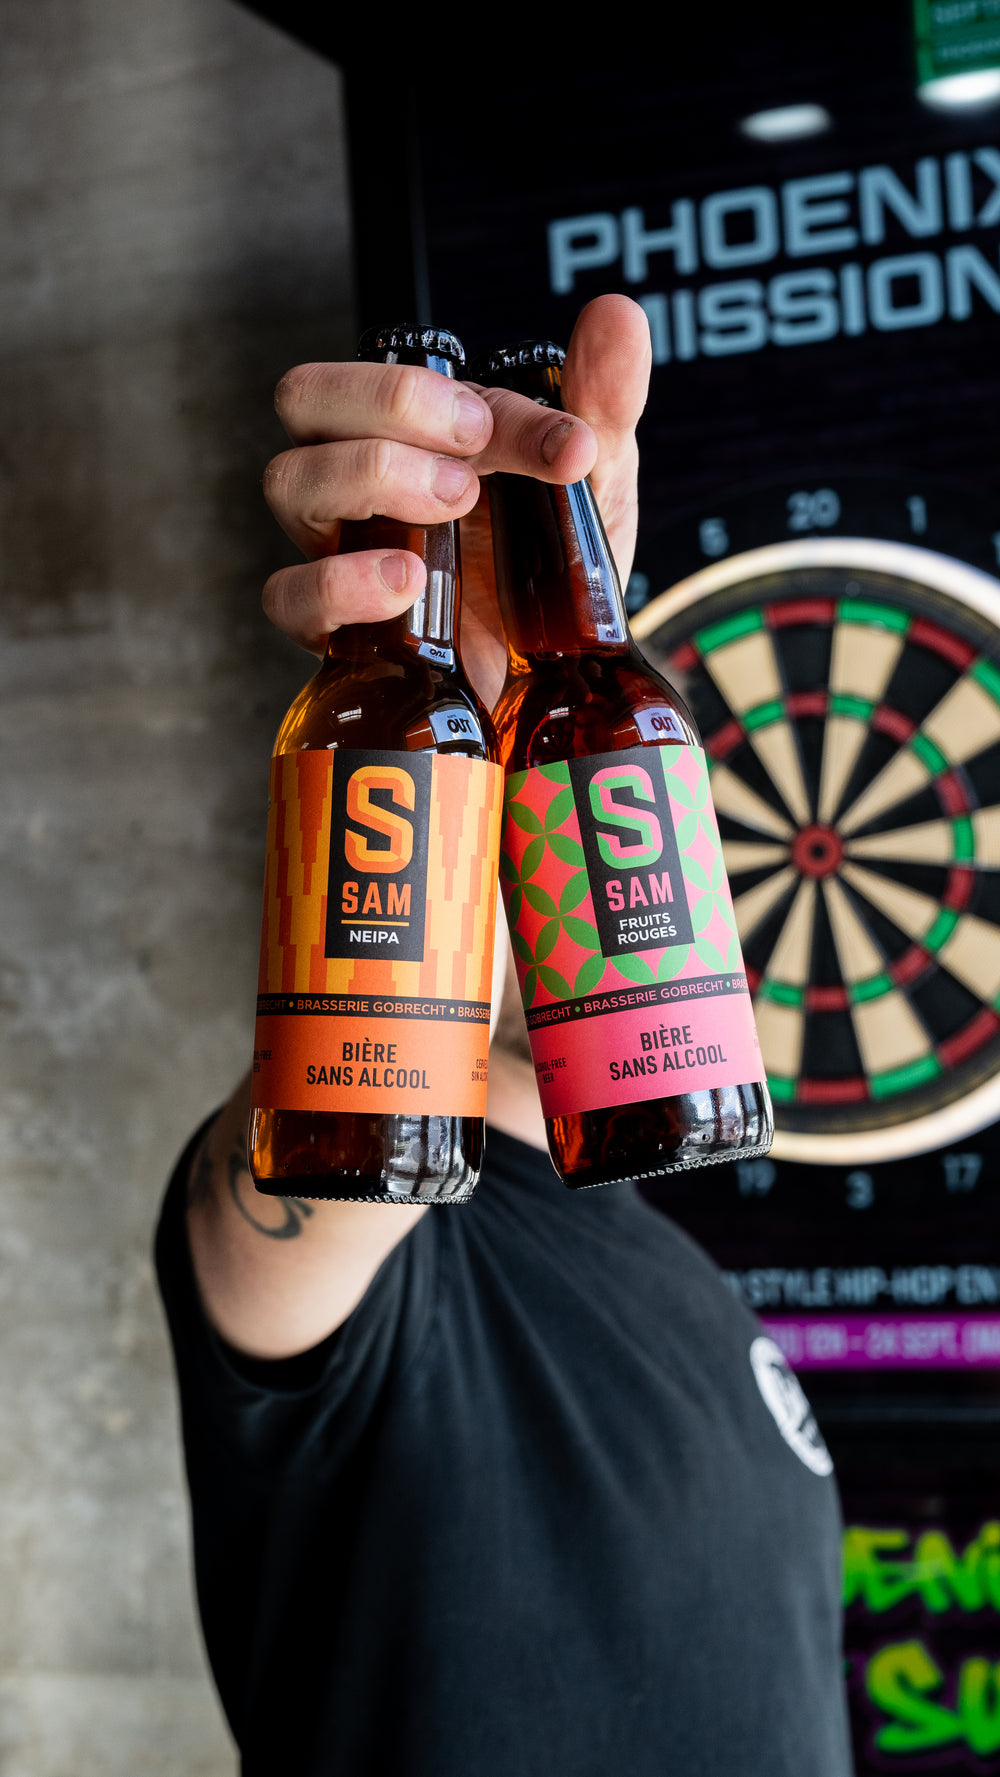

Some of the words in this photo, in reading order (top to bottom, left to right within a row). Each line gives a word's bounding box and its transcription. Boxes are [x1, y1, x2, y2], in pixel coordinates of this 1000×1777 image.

[786, 488, 841, 531] 20
[906, 495, 927, 534] 1
[446, 718, 473, 734] OUT
[650, 716, 677, 732] OUT
[344, 765, 416, 874] S
[588, 764, 664, 870] S
[341, 881, 412, 916] SAM
[605, 871, 675, 912] SAM
[617, 925, 678, 945] ROUGES
[619, 912, 671, 931] FRUITS
[349, 930, 400, 944] NEIPA
[297, 999, 370, 1012] BRASSERIE
[373, 1001, 447, 1016] GOBRECHT
[584, 989, 658, 1013] BRASSERIE
[660, 980, 724, 999] GOBRECHT
[342, 1037, 397, 1063] BIÈRE
[640, 1024, 694, 1052] BIÈRE
[609, 1055, 658, 1081] SANS
[663, 1044, 727, 1072] ALCOOL
[306, 1065, 354, 1086] SANS
[358, 1067, 430, 1089] ALCOOL
